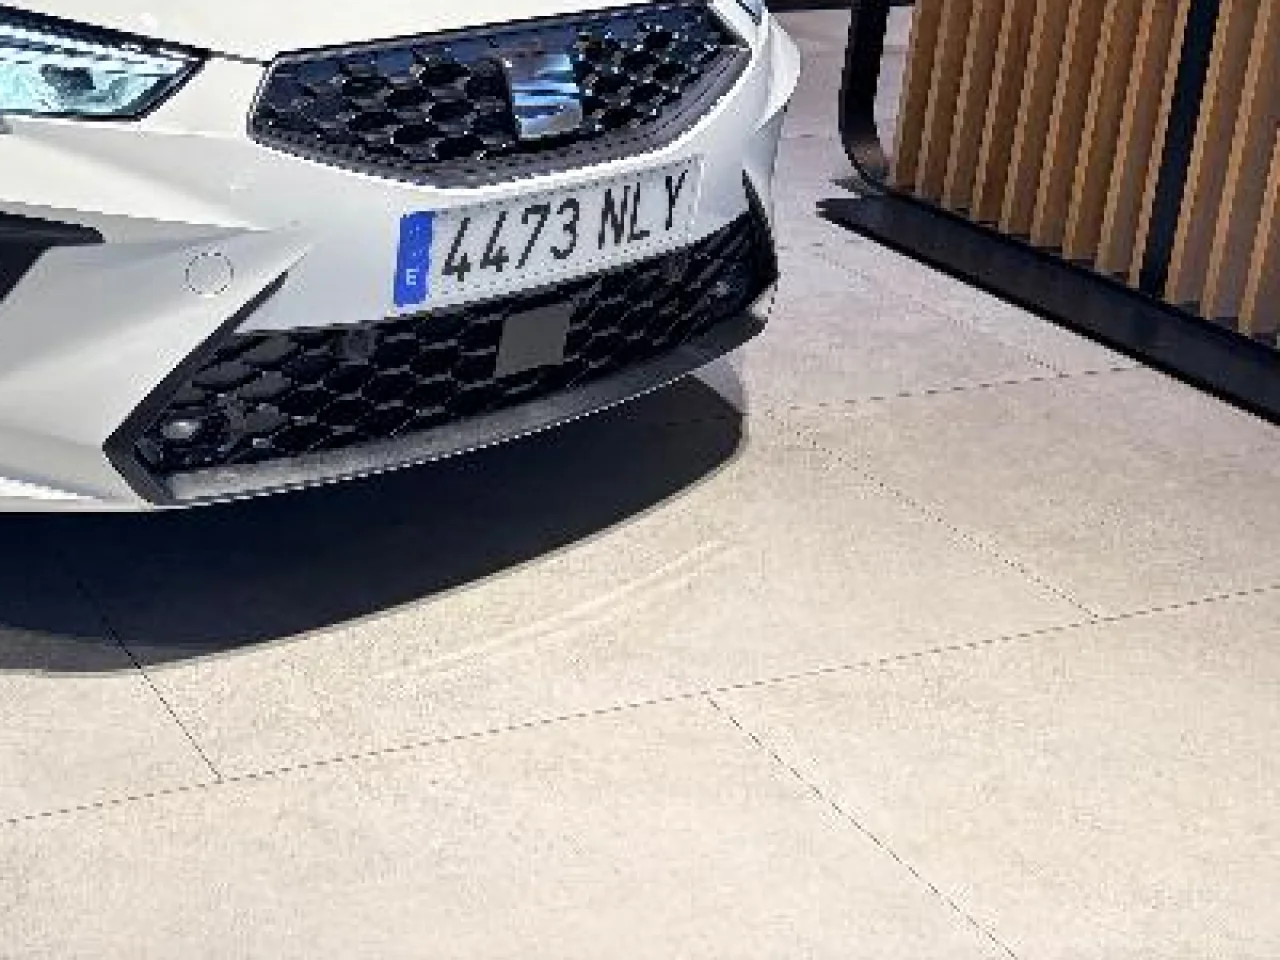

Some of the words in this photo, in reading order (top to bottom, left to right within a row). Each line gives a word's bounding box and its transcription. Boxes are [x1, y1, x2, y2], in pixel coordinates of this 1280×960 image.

[441, 197, 580, 282] 4473
[598, 168, 689, 251] NLY
[405, 267, 418, 286] E
